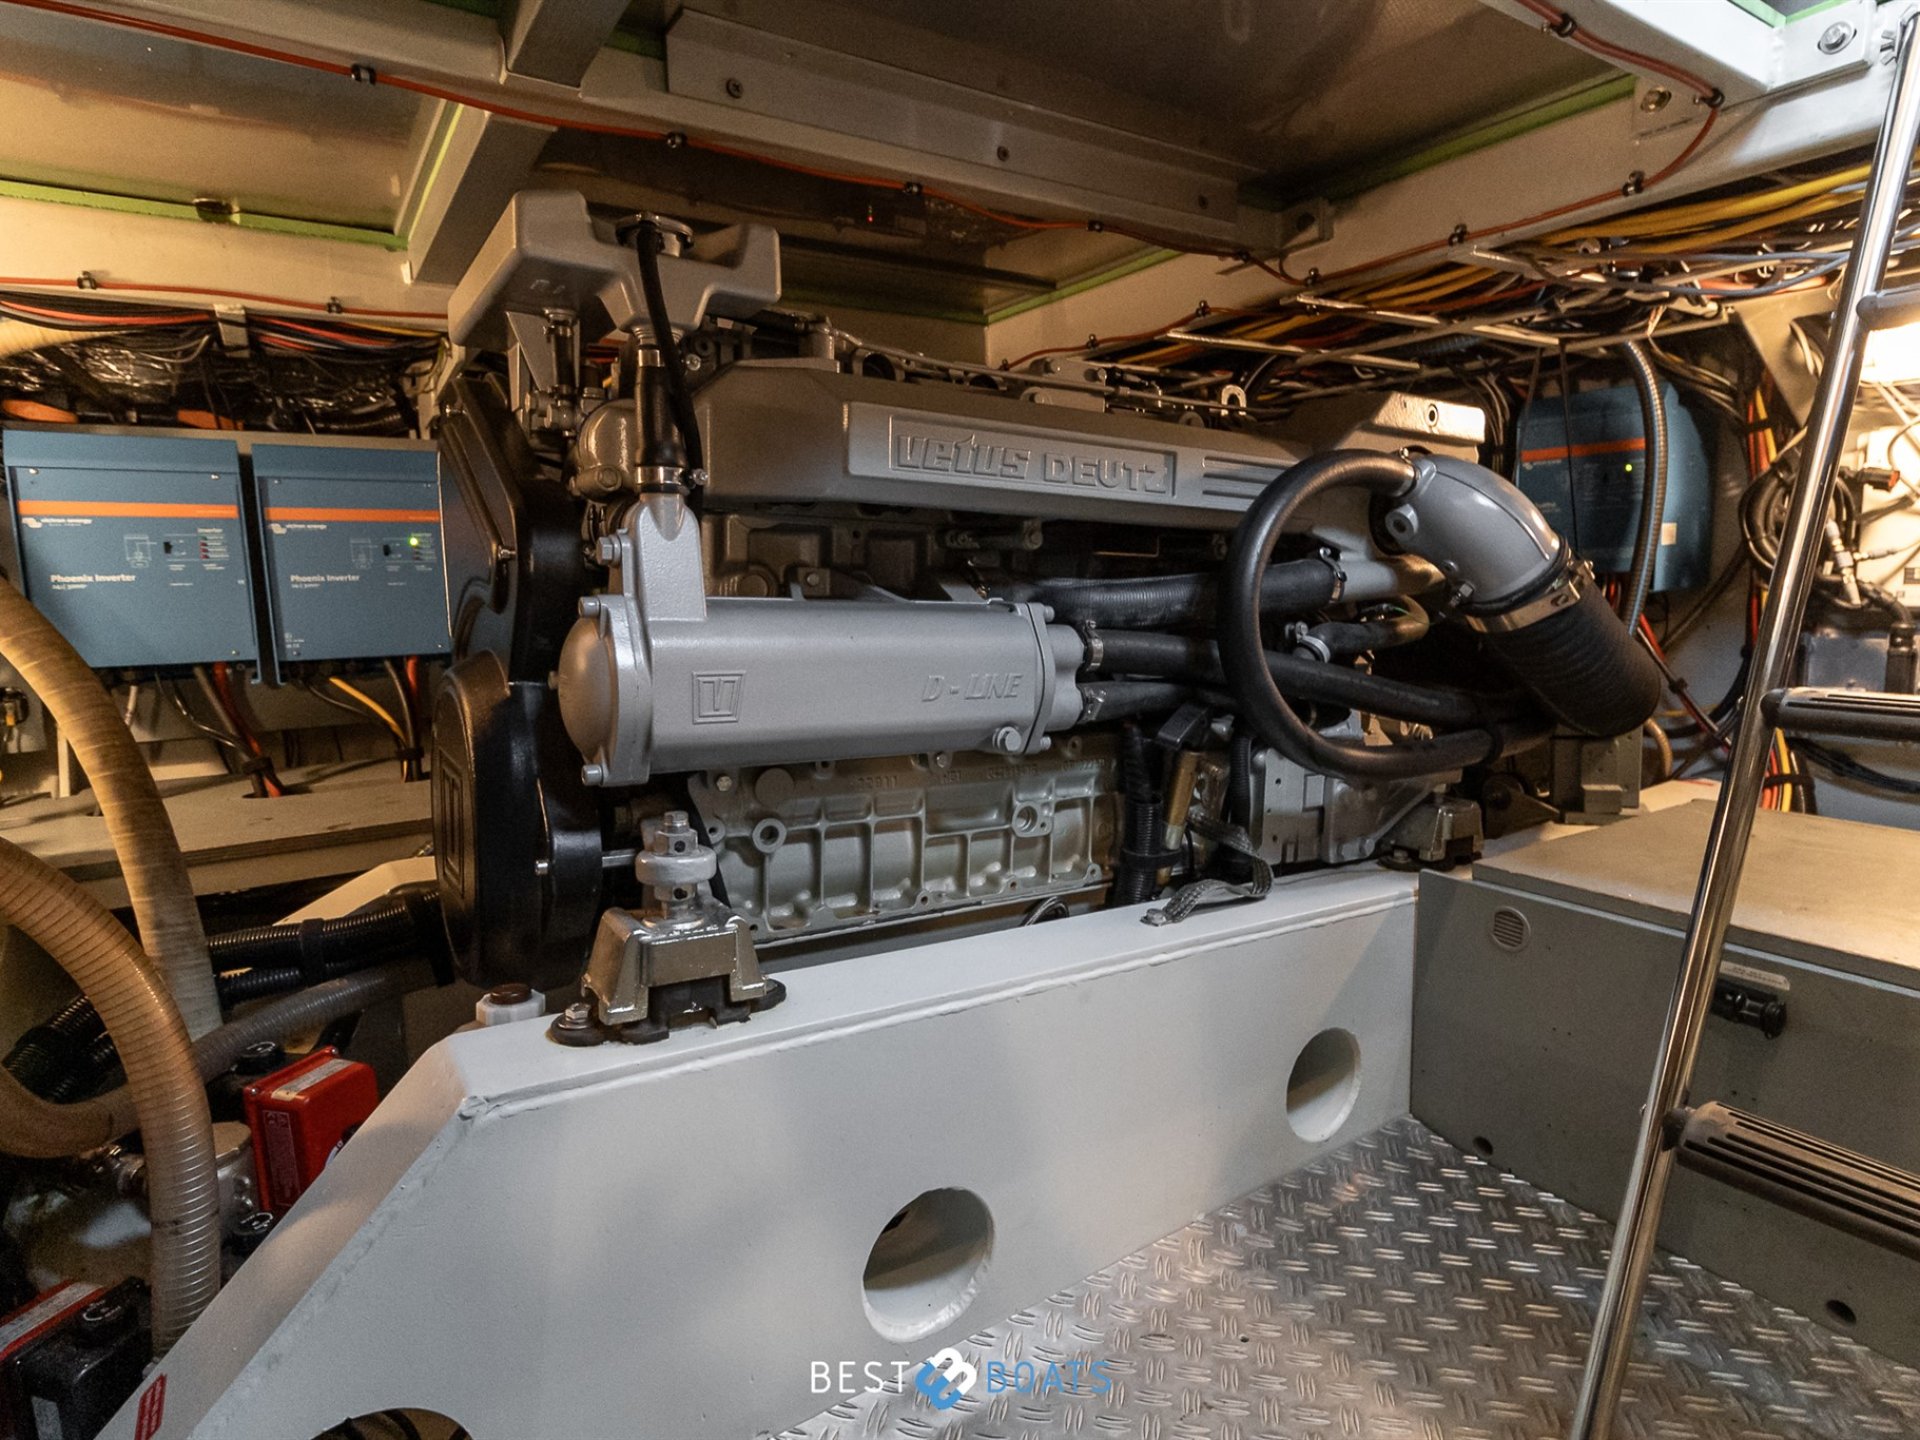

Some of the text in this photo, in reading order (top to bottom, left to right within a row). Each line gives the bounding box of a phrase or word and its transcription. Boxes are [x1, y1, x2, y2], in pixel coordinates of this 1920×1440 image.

[1043, 453, 1168, 494] DEUTZ
[50, 574, 136, 583] Phoenix Inverter
[290, 573, 360, 583] Phoenix Inverter
